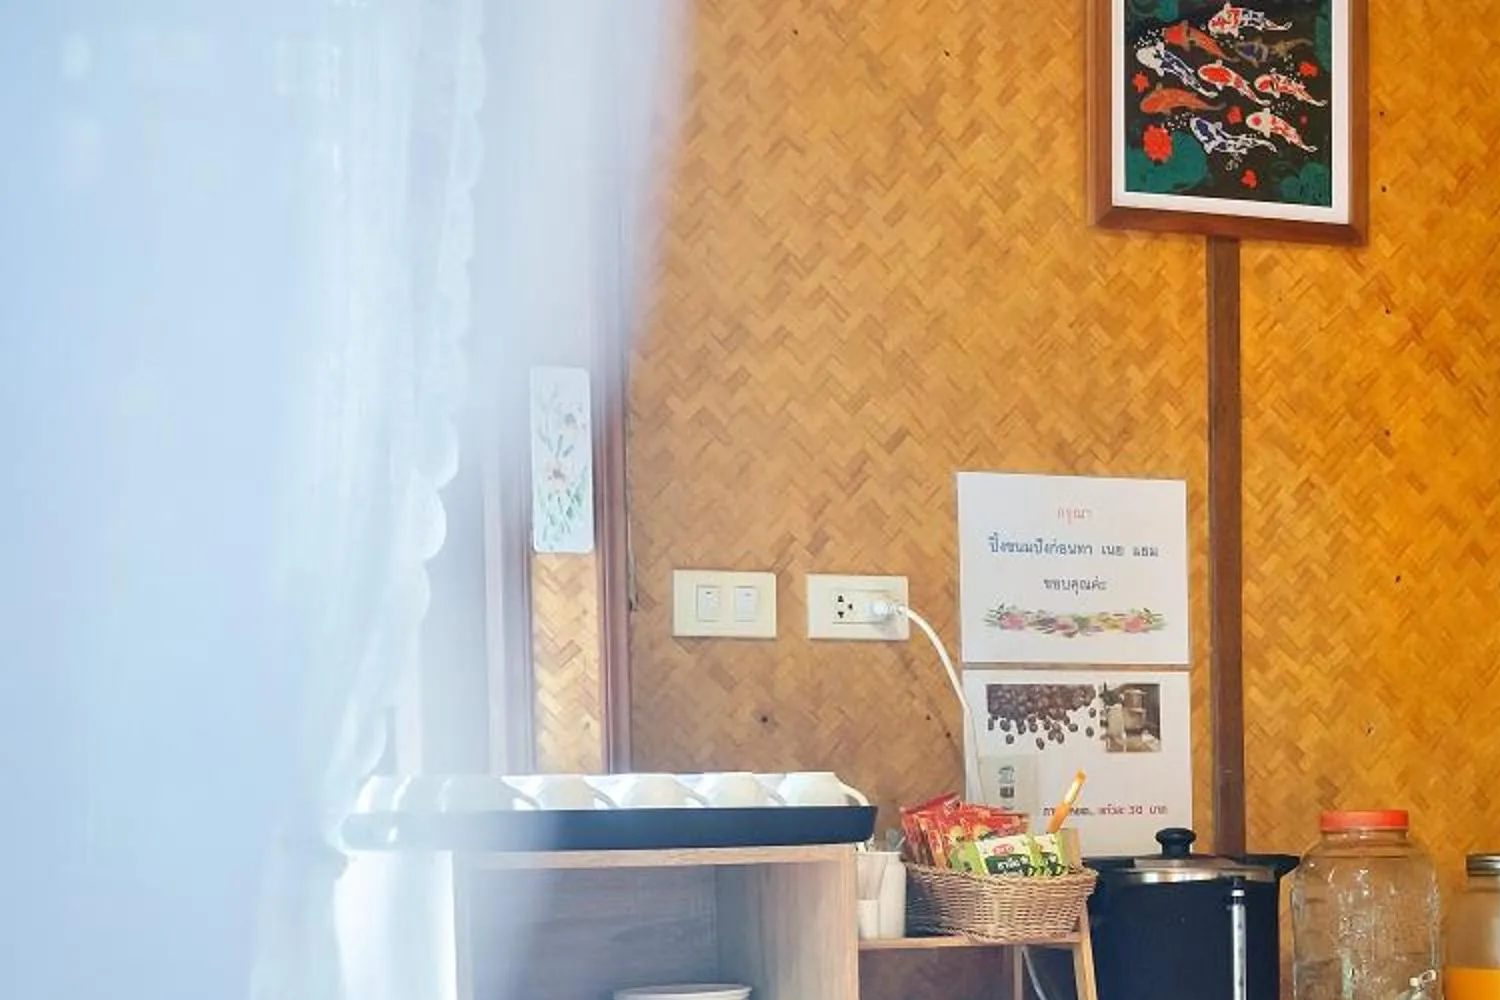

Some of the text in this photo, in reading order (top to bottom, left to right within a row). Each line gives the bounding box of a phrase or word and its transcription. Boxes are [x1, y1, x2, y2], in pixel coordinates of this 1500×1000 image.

[1057, 506, 1093, 526] กรุณา
[1043, 575, 1108, 596] ขอบคุณค่ะ
